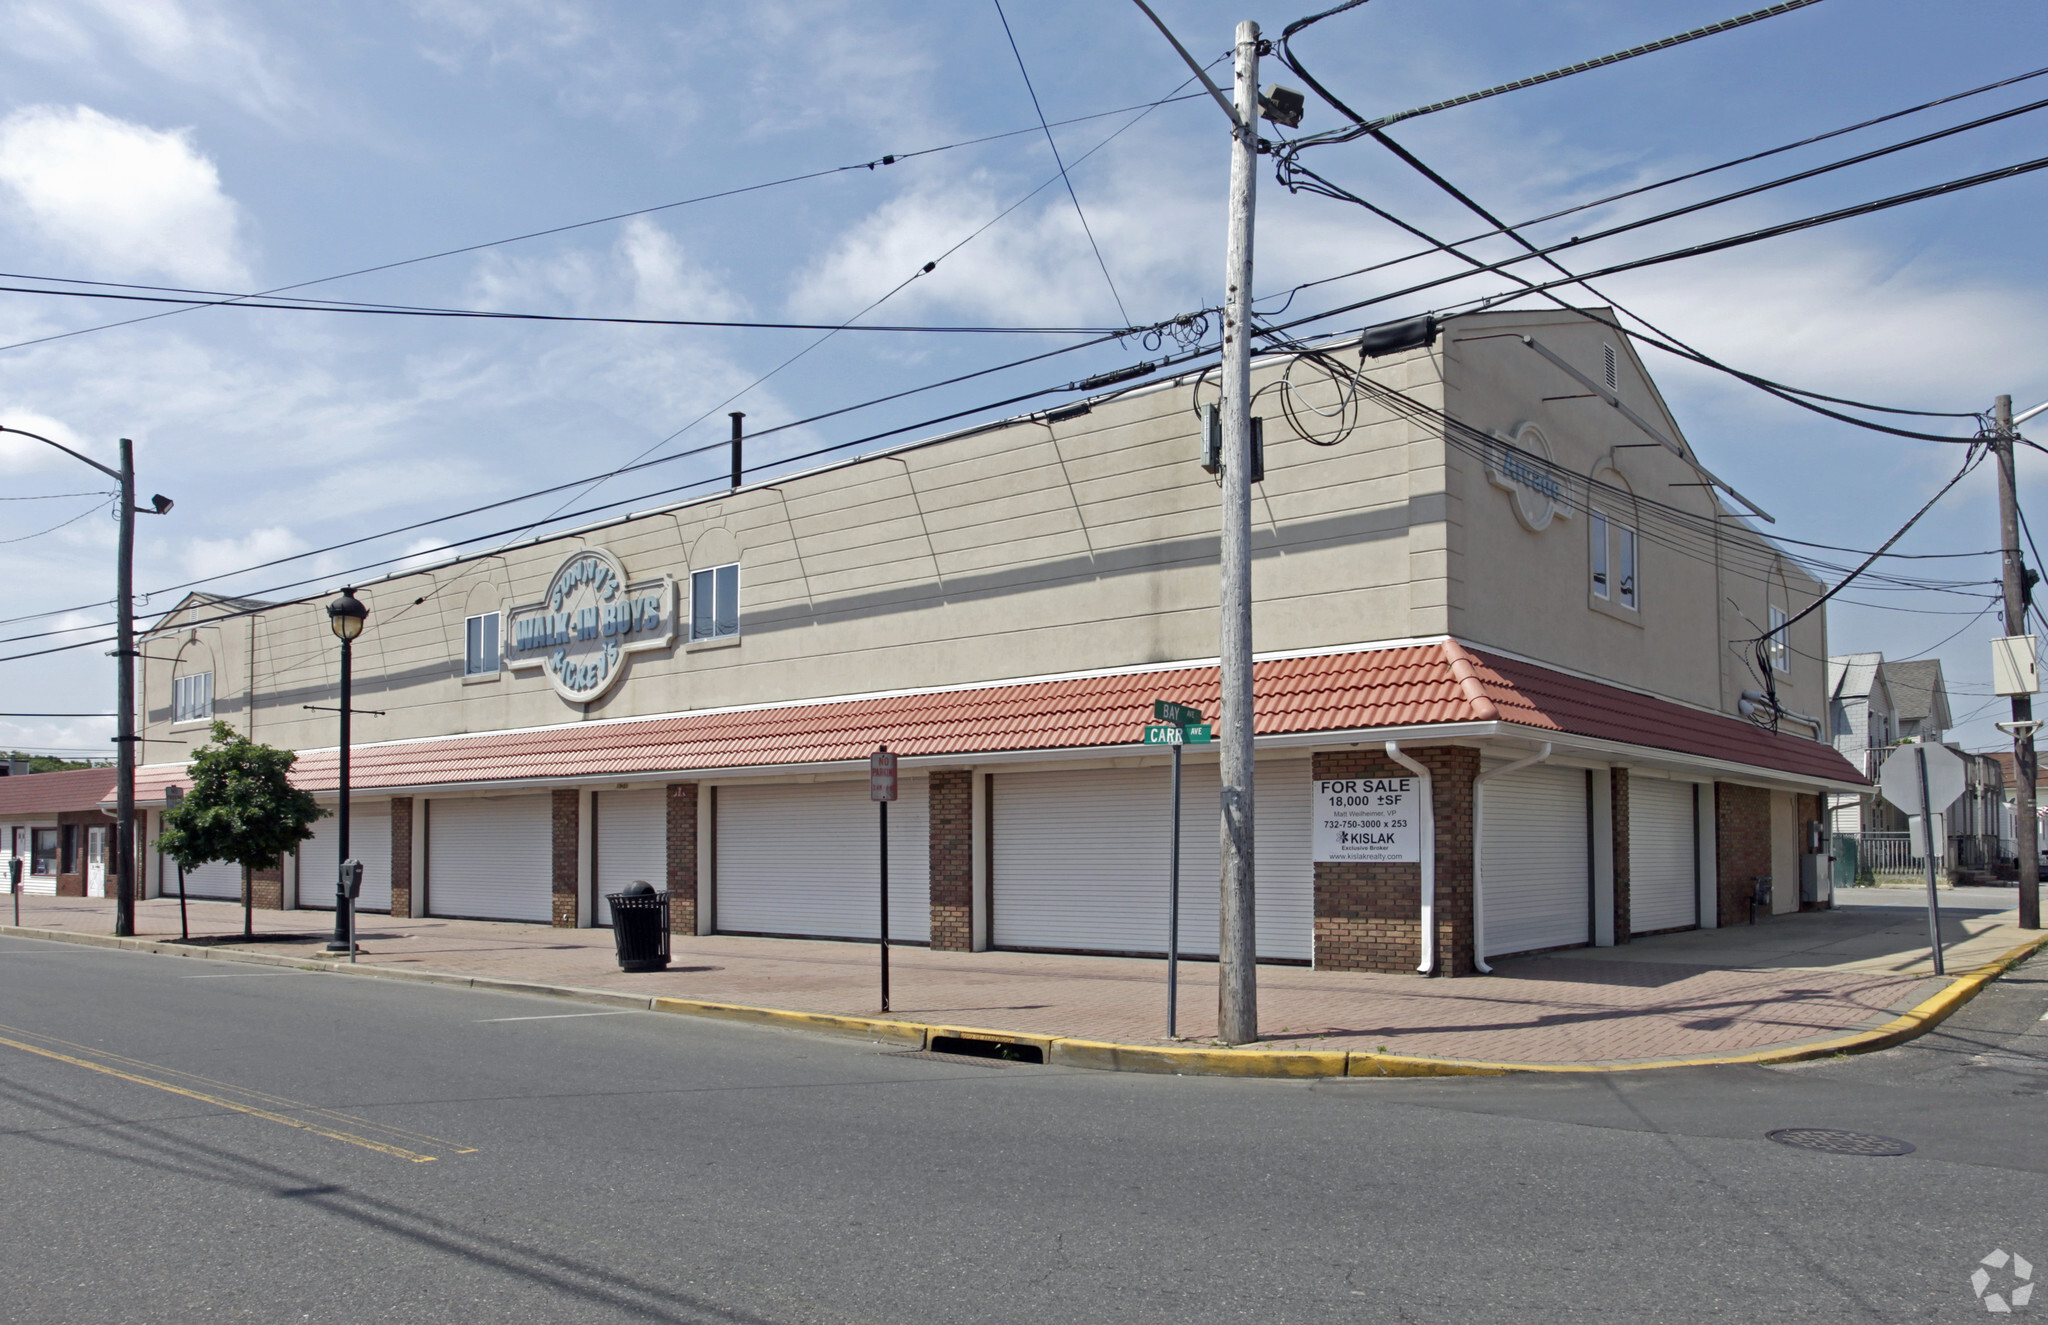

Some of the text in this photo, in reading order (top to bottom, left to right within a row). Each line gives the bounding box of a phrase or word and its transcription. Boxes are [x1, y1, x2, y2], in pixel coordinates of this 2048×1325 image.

[551, 560, 620, 612] SONNY'S
[516, 595, 660, 652] WALK-IN BOYS
[551, 638, 619, 692] RICKEY'S
[1163, 704, 1195, 720] BAY AVE
[1150, 727, 1202, 743] CARR AVE
[879, 757, 889, 766] NO
[1321, 779, 1410, 794] FOR SALE
[1329, 796, 1369, 808] 18,000
[1324, 820, 1381, 829] 732-750-3000
[1391, 819, 1408, 828] 253
[1350, 832, 1395, 844] KISLAK
[1329, 852, 1403, 862] www.kislakrealty.com
